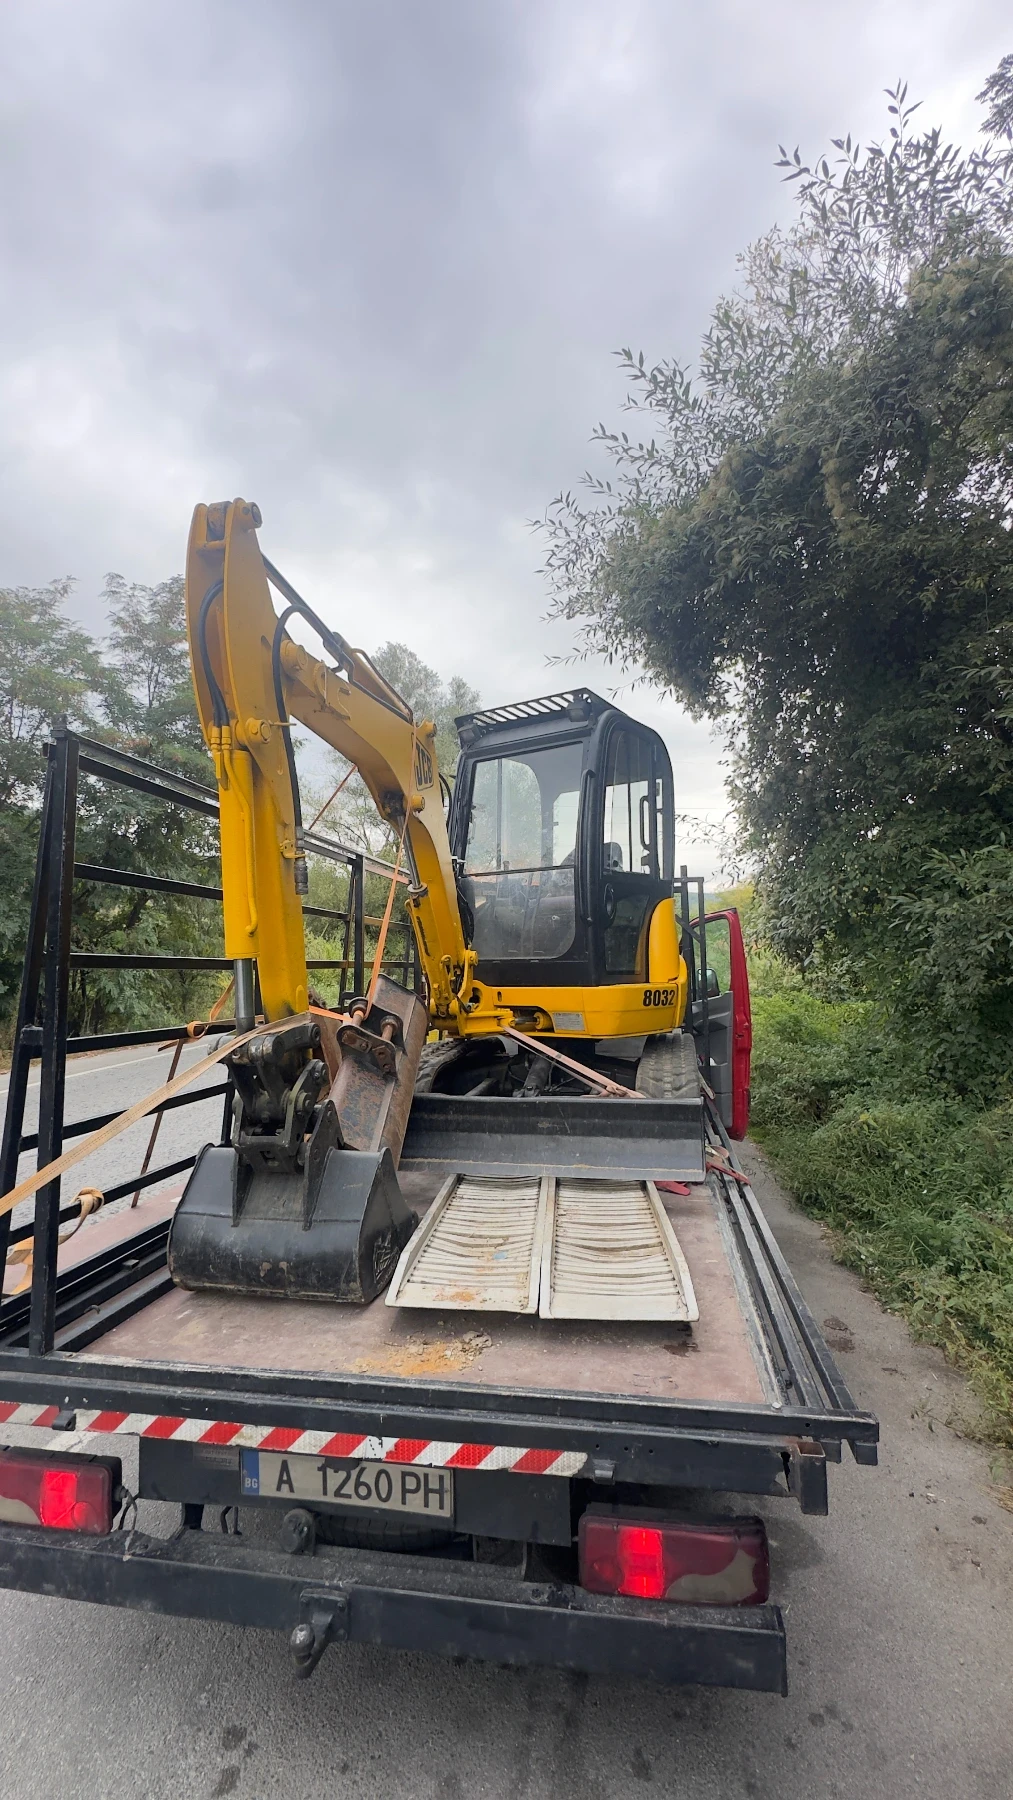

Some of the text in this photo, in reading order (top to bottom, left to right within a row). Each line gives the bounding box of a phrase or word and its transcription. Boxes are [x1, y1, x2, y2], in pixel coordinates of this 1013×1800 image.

[642, 989, 676, 1007] 8032
[244, 1477, 258, 1489] BG
[276, 1459, 445, 1510] A 1260 PH
